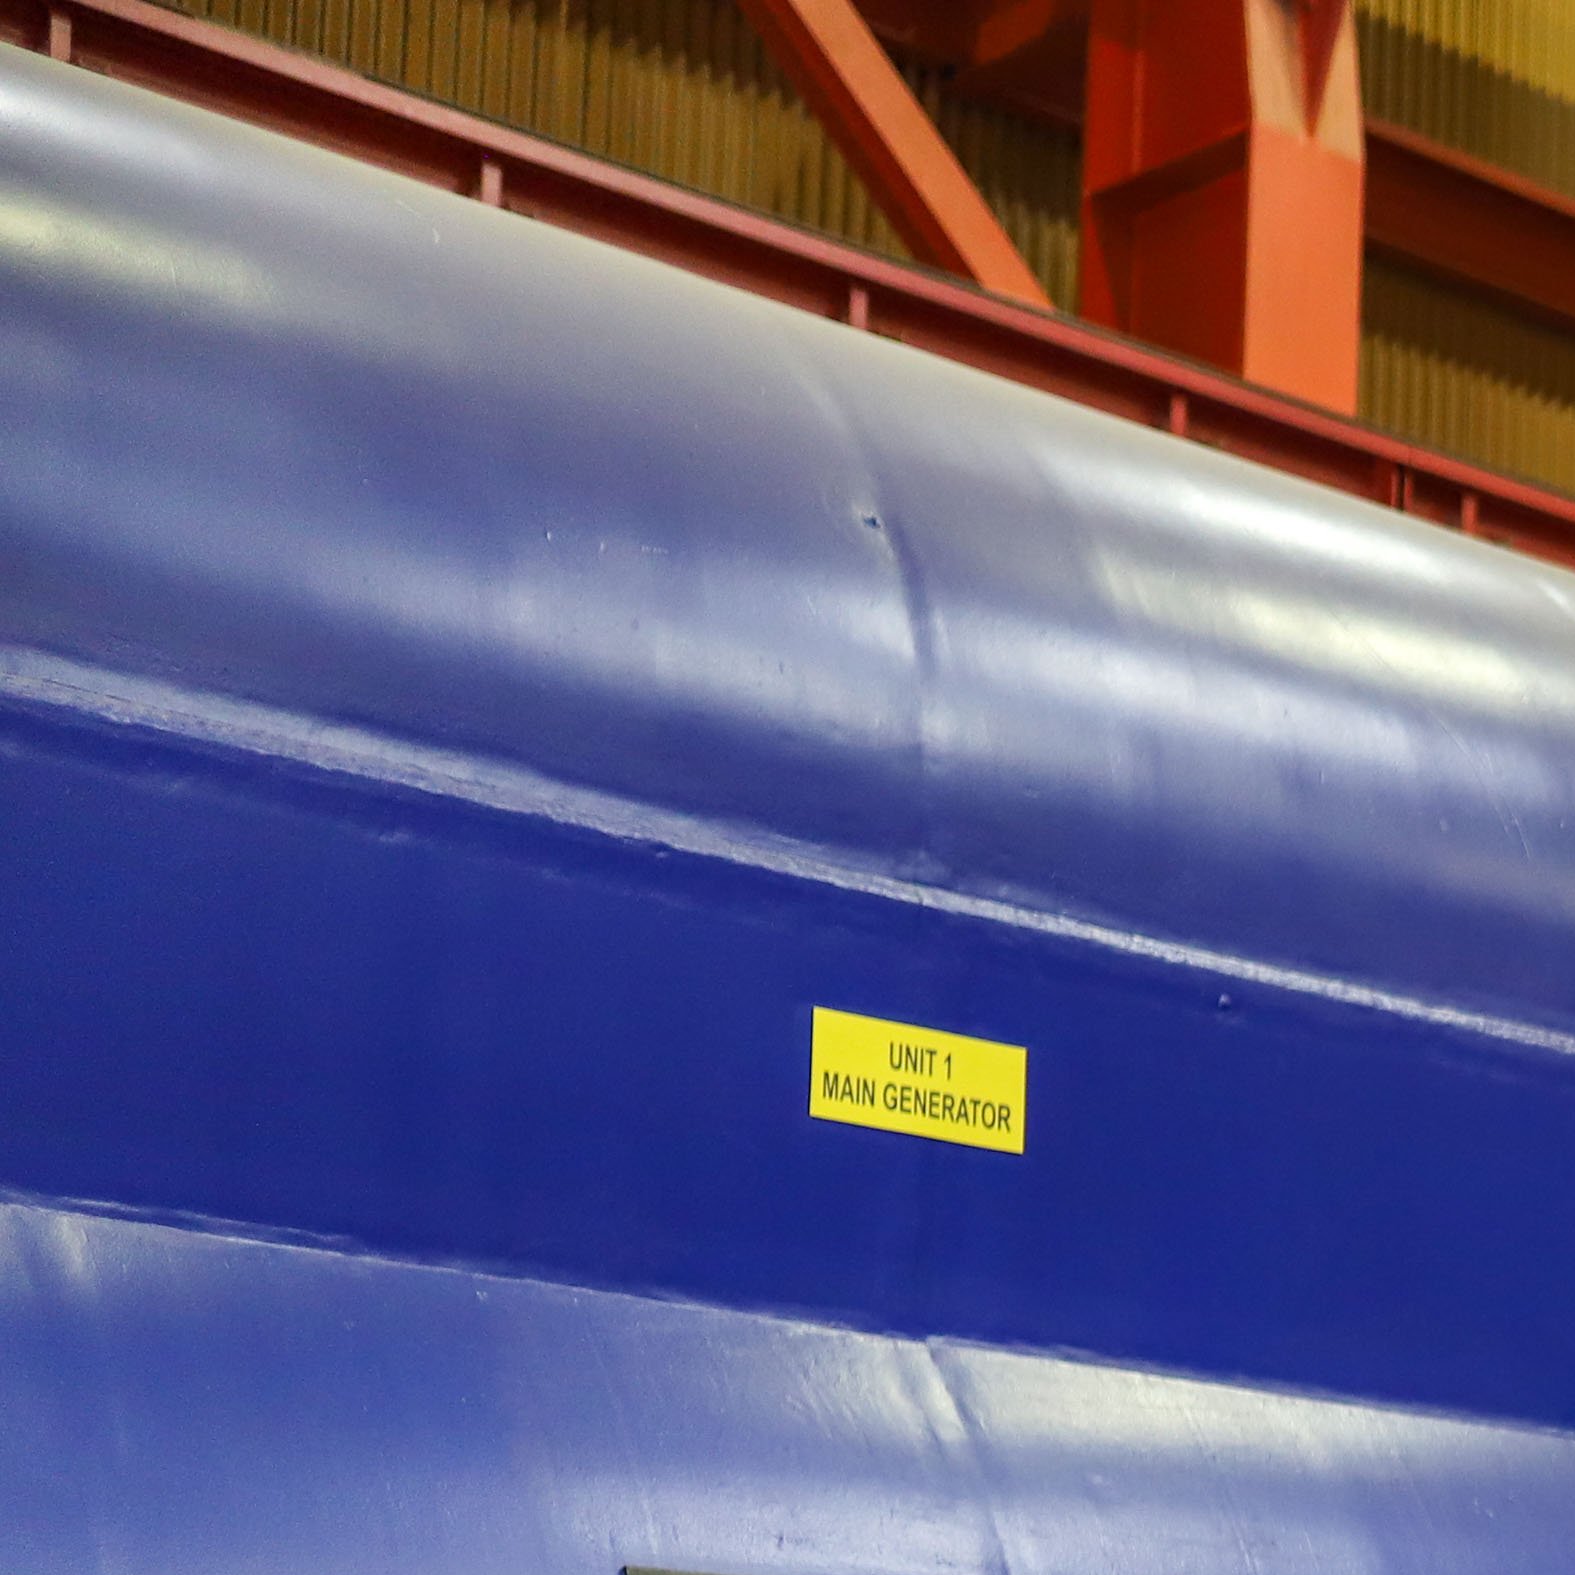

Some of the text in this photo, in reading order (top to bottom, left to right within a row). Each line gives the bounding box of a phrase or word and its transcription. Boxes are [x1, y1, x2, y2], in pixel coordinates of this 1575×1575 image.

[889, 1042, 953, 1080] UNIT 1
[823, 1071, 1011, 1132] MAIN GENERATOR
